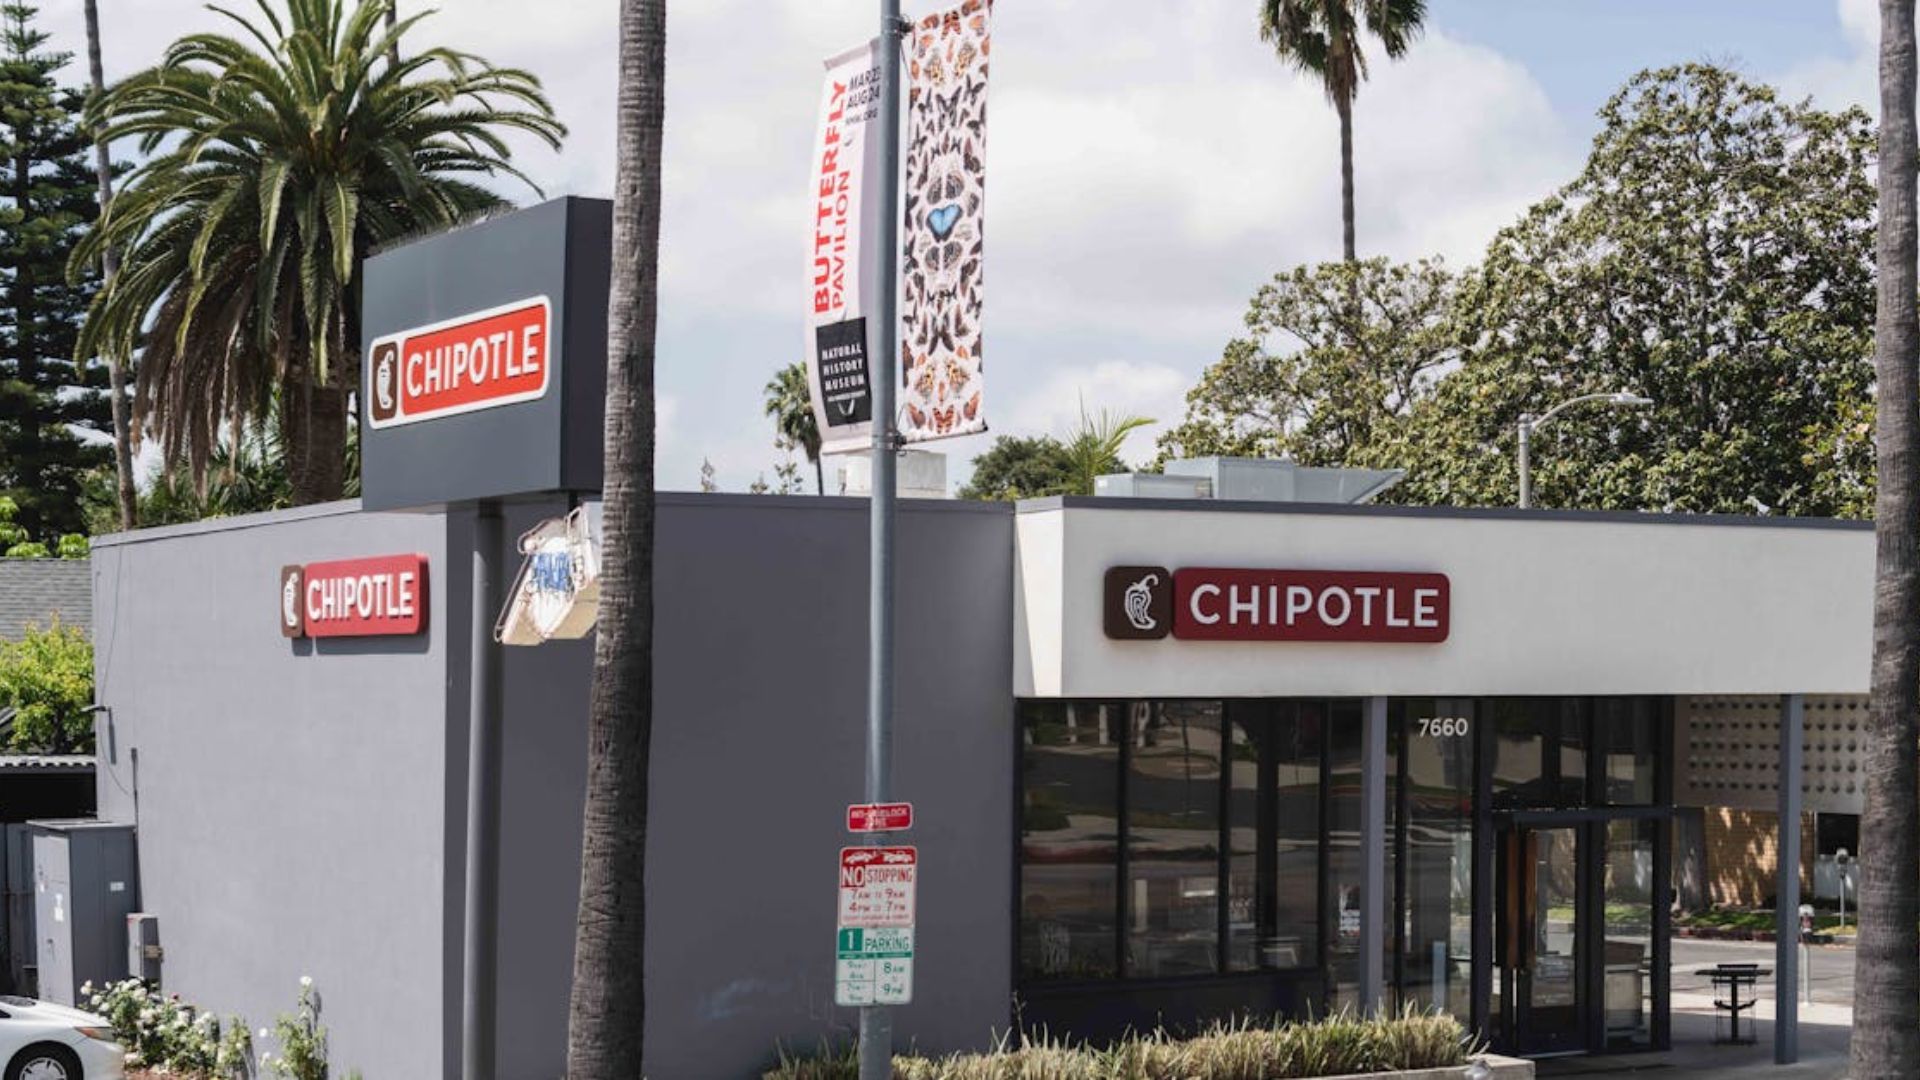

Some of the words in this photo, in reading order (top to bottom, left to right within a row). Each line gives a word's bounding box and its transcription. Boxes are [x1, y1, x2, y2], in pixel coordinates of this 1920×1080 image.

[815, 81, 847, 313] BUTTERFLY
[832, 169, 850, 309] PAVILION
[406, 324, 541, 398] CHIPOTLE
[822, 342, 862, 361] NATURAL
[823, 358, 863, 376] HISTORY
[825, 373, 865, 391] MUSEUM
[306, 571, 415, 620] CHIPOTLE
[1190, 583, 1439, 628] CHIPOTLE
[1418, 717, 1469, 738] 7660
[842, 866, 865, 886] NO
[866, 868, 912, 883] STOPPING
[847, 930, 854, 950] 1
[865, 936, 909, 951] PARKING
